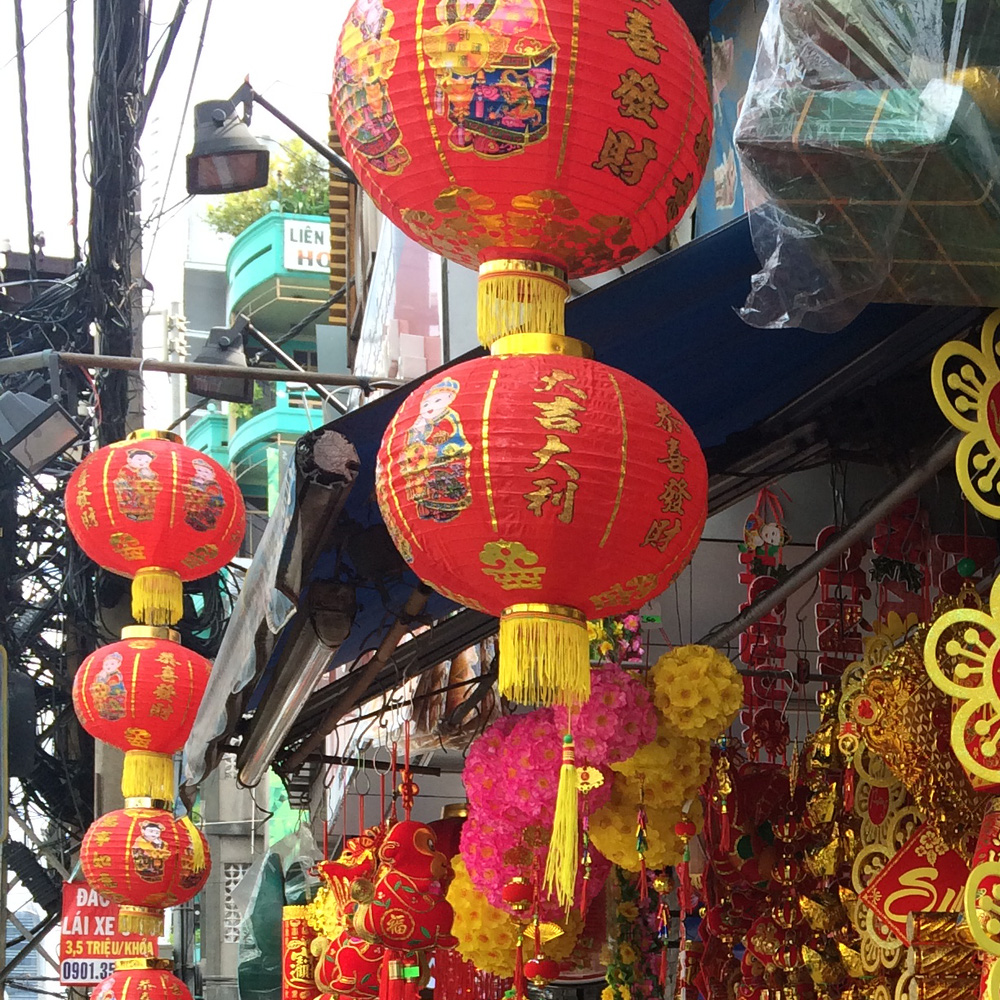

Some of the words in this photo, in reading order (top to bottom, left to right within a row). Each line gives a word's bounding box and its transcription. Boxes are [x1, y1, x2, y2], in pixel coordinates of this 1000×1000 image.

[592, 0, 669, 186] 喜發財
[290, 226, 324, 245] LIÊN
[523, 368, 588, 524] 大吉大利
[640, 401, 692, 553] 恭喜發財
[62, 911, 89, 936] LÁI
[94, 916, 115, 936] XE
[387, 914, 407, 935] 福
[65, 941, 83, 957] 3,5
